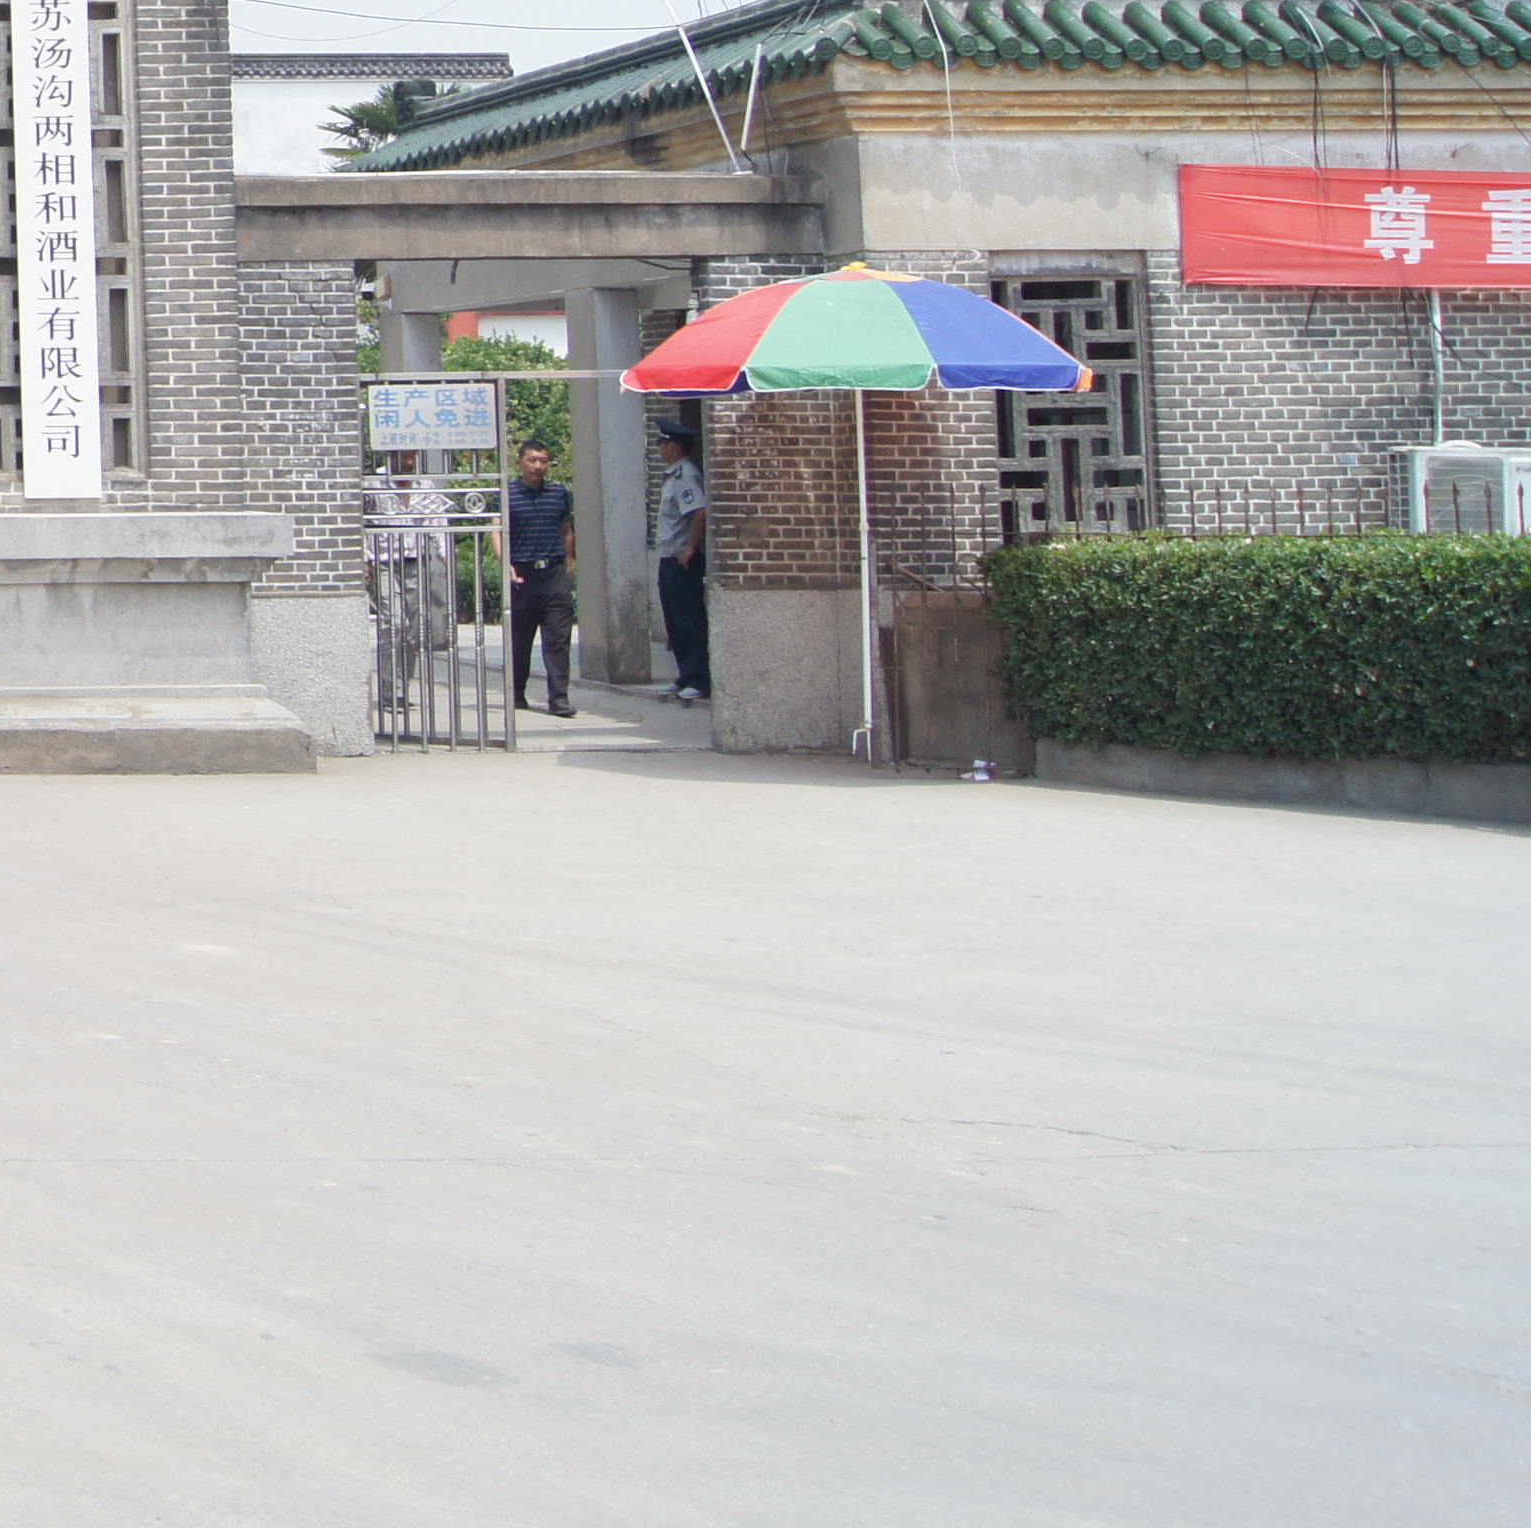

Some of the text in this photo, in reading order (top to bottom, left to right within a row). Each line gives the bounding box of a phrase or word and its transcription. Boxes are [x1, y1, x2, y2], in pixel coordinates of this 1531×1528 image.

[1363, 185, 1531, 265] 尊重
[373, 387, 489, 408] 生产区域
[374, 408, 490, 429] 闲人免进
